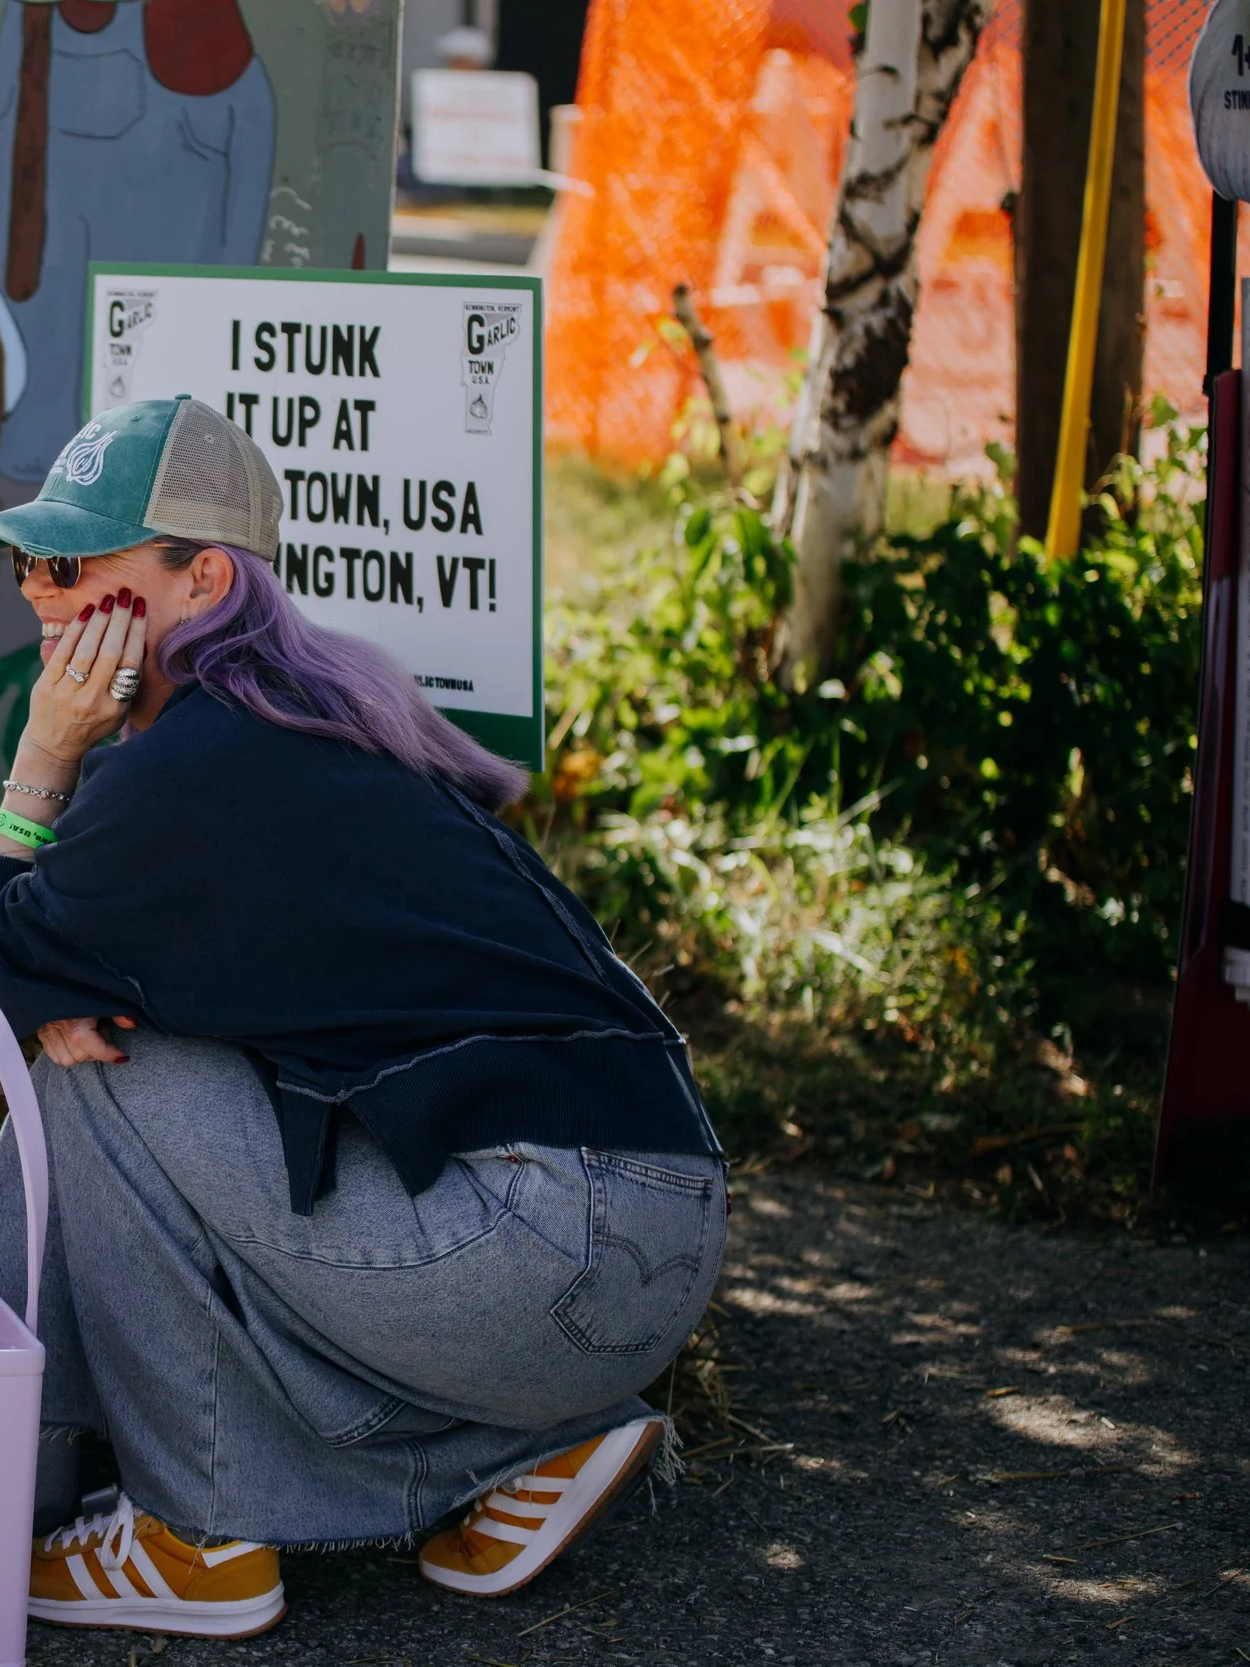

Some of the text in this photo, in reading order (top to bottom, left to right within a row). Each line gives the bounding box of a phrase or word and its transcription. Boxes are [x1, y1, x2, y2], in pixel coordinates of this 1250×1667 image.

[1224, 91, 1250, 110] STIN
[231, 320, 382, 378] I STUNK
[467, 313, 517, 356] GARLIC
[468, 359, 494, 375] TOWN
[272, 395, 321, 448] UP
[332, 398, 377, 451] AT
[284, 469, 484, 536] TOWN, USA
[436, 555, 497, 613] VT!
